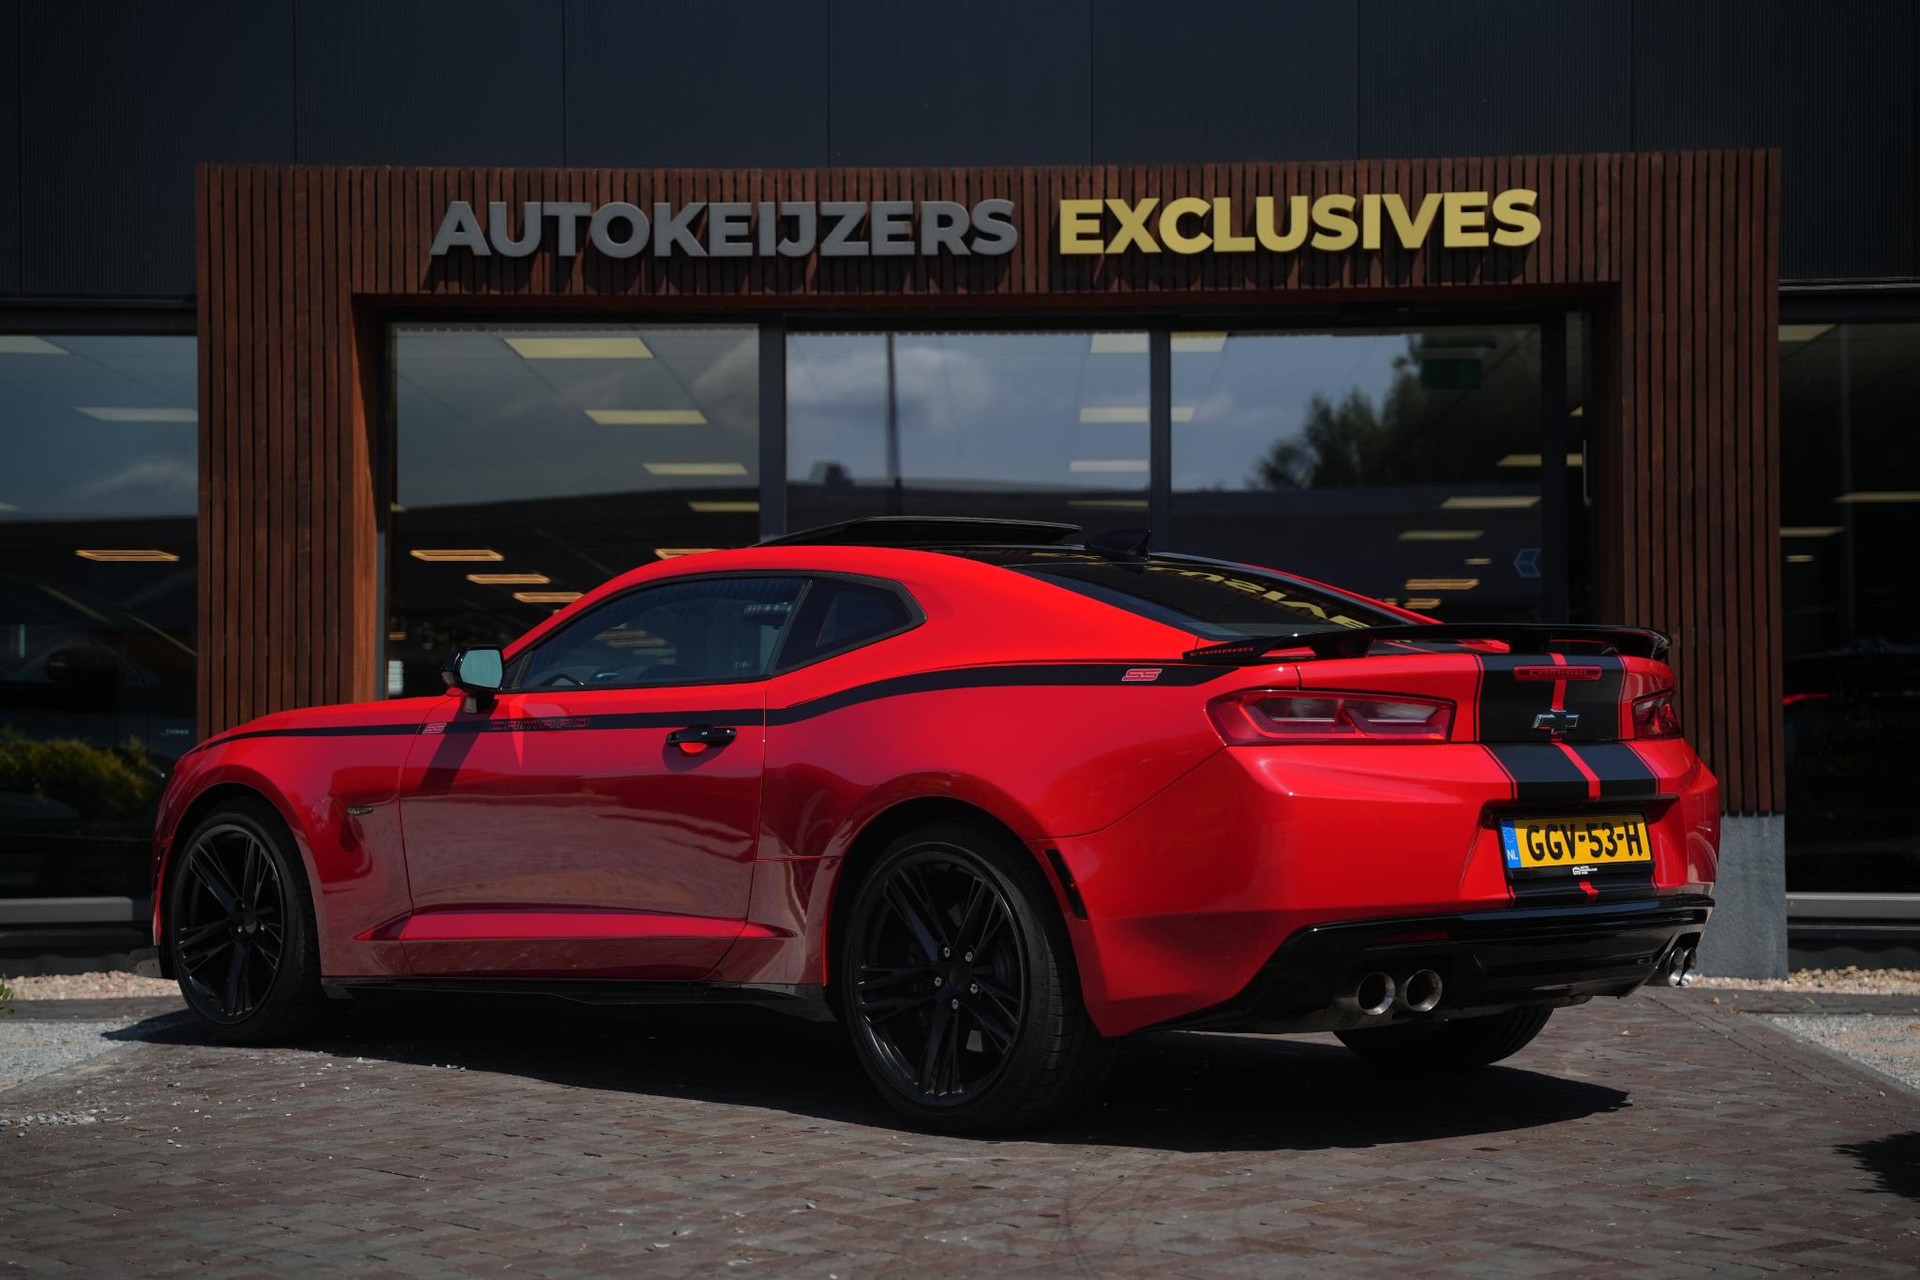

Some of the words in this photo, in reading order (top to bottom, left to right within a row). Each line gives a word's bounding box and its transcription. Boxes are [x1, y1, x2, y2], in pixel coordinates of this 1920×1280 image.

[430, 198, 1018, 258] AUTOKEIJZERS
[1059, 188, 1541, 255] EXCLUSIVES
[1121, 668, 1163, 682] SS
[422, 722, 447, 735] SS
[489, 717, 591, 731] CAMARO
[1507, 849, 1519, 861] NL
[1526, 821, 1644, 861] GGV-53-H
